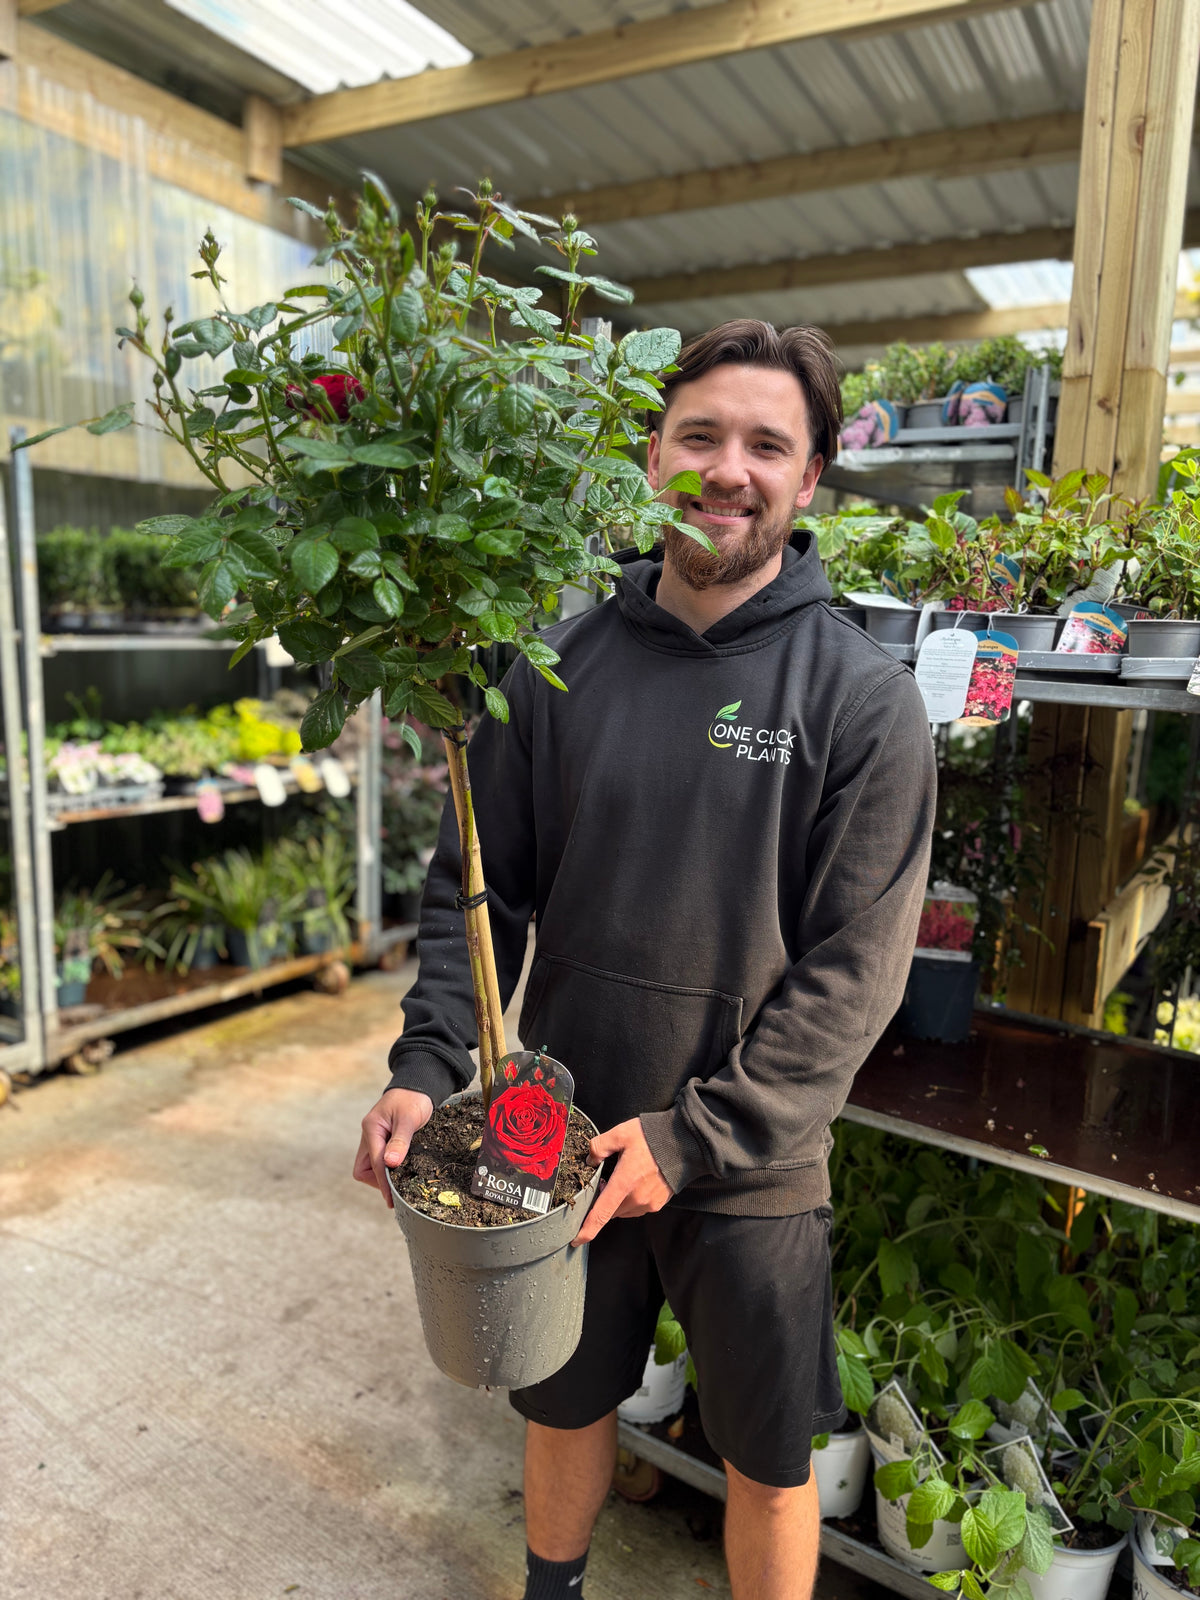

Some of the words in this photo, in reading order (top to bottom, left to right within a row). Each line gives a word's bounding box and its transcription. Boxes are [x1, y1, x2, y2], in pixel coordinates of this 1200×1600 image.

[714, 723, 753, 742] ONE
[736, 744, 792, 765] PLANTS
[487, 1174, 522, 1196] ROSA
[485, 1190, 504, 1201] ROYAL
[506, 1197, 519, 1206] RED
